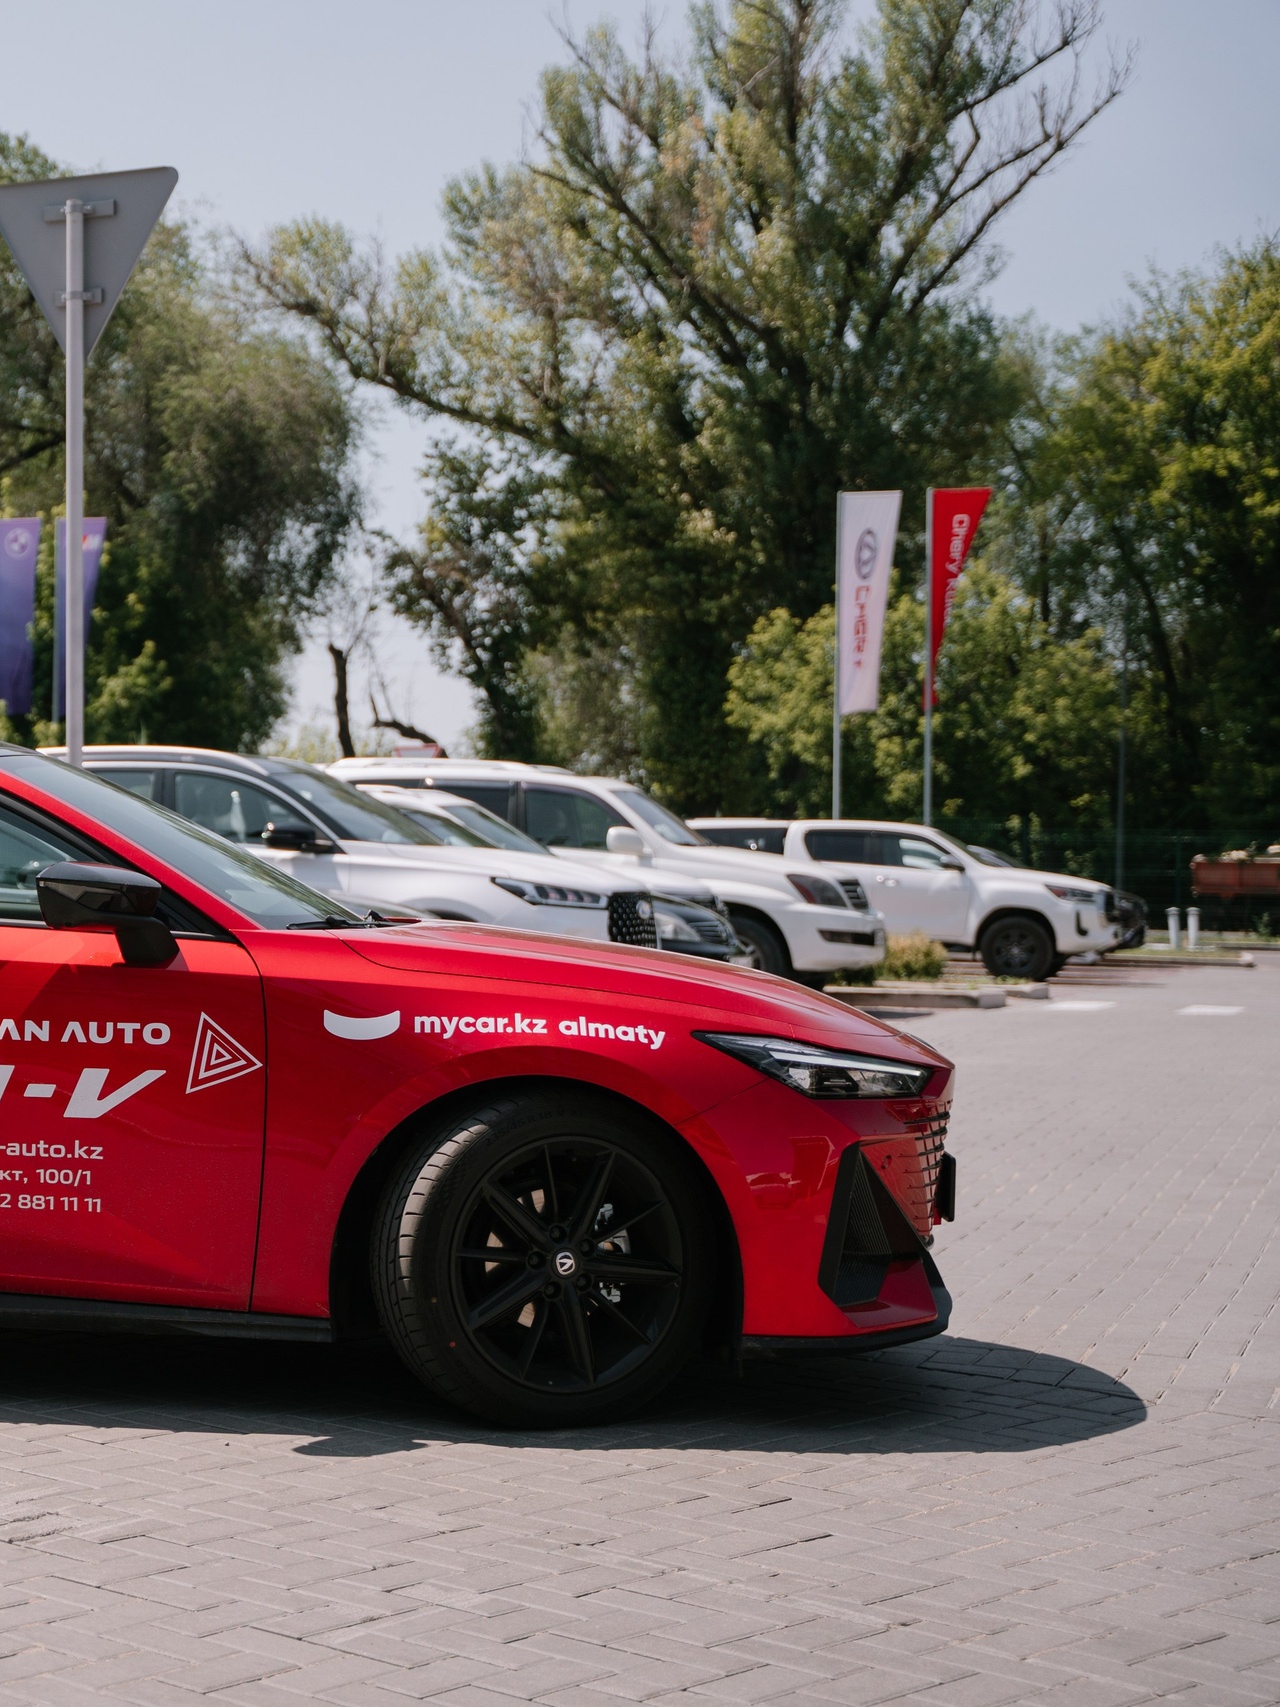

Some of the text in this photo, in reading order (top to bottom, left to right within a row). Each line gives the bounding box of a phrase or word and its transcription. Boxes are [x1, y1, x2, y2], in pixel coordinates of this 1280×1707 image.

[945, 513, 970, 574] Chery
[60, 1021, 171, 1045] AUTO
[414, 1012, 666, 1050] mycar.kz almaty
[35, 1168, 91, 1187] 100/1
[17, 1194, 54, 1210] 881
[60, 1196, 78, 1212] 11
[83, 1197, 101, 1213] 11
